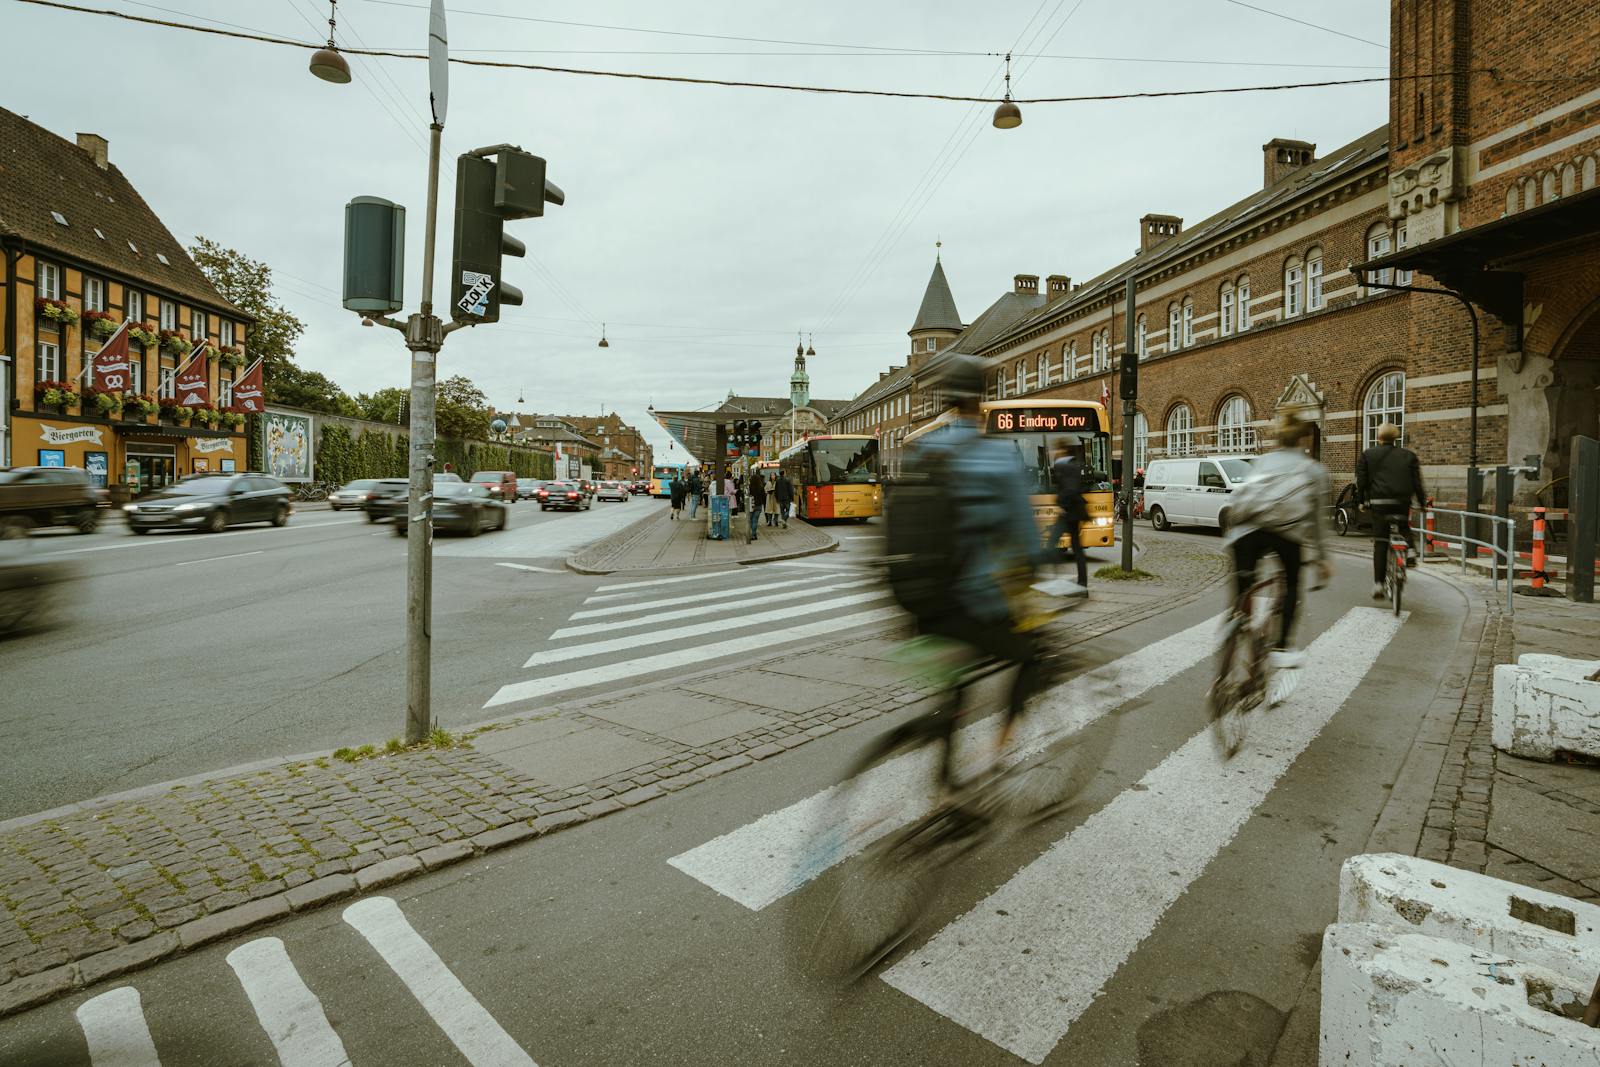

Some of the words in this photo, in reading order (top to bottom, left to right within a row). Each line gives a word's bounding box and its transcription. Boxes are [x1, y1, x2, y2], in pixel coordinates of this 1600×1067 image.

[997, 413, 1013, 429] 66
[1019, 414, 1057, 430] Emdrup
[1061, 413, 1086, 427] Torv
[50, 430, 94, 441] Biergarten
